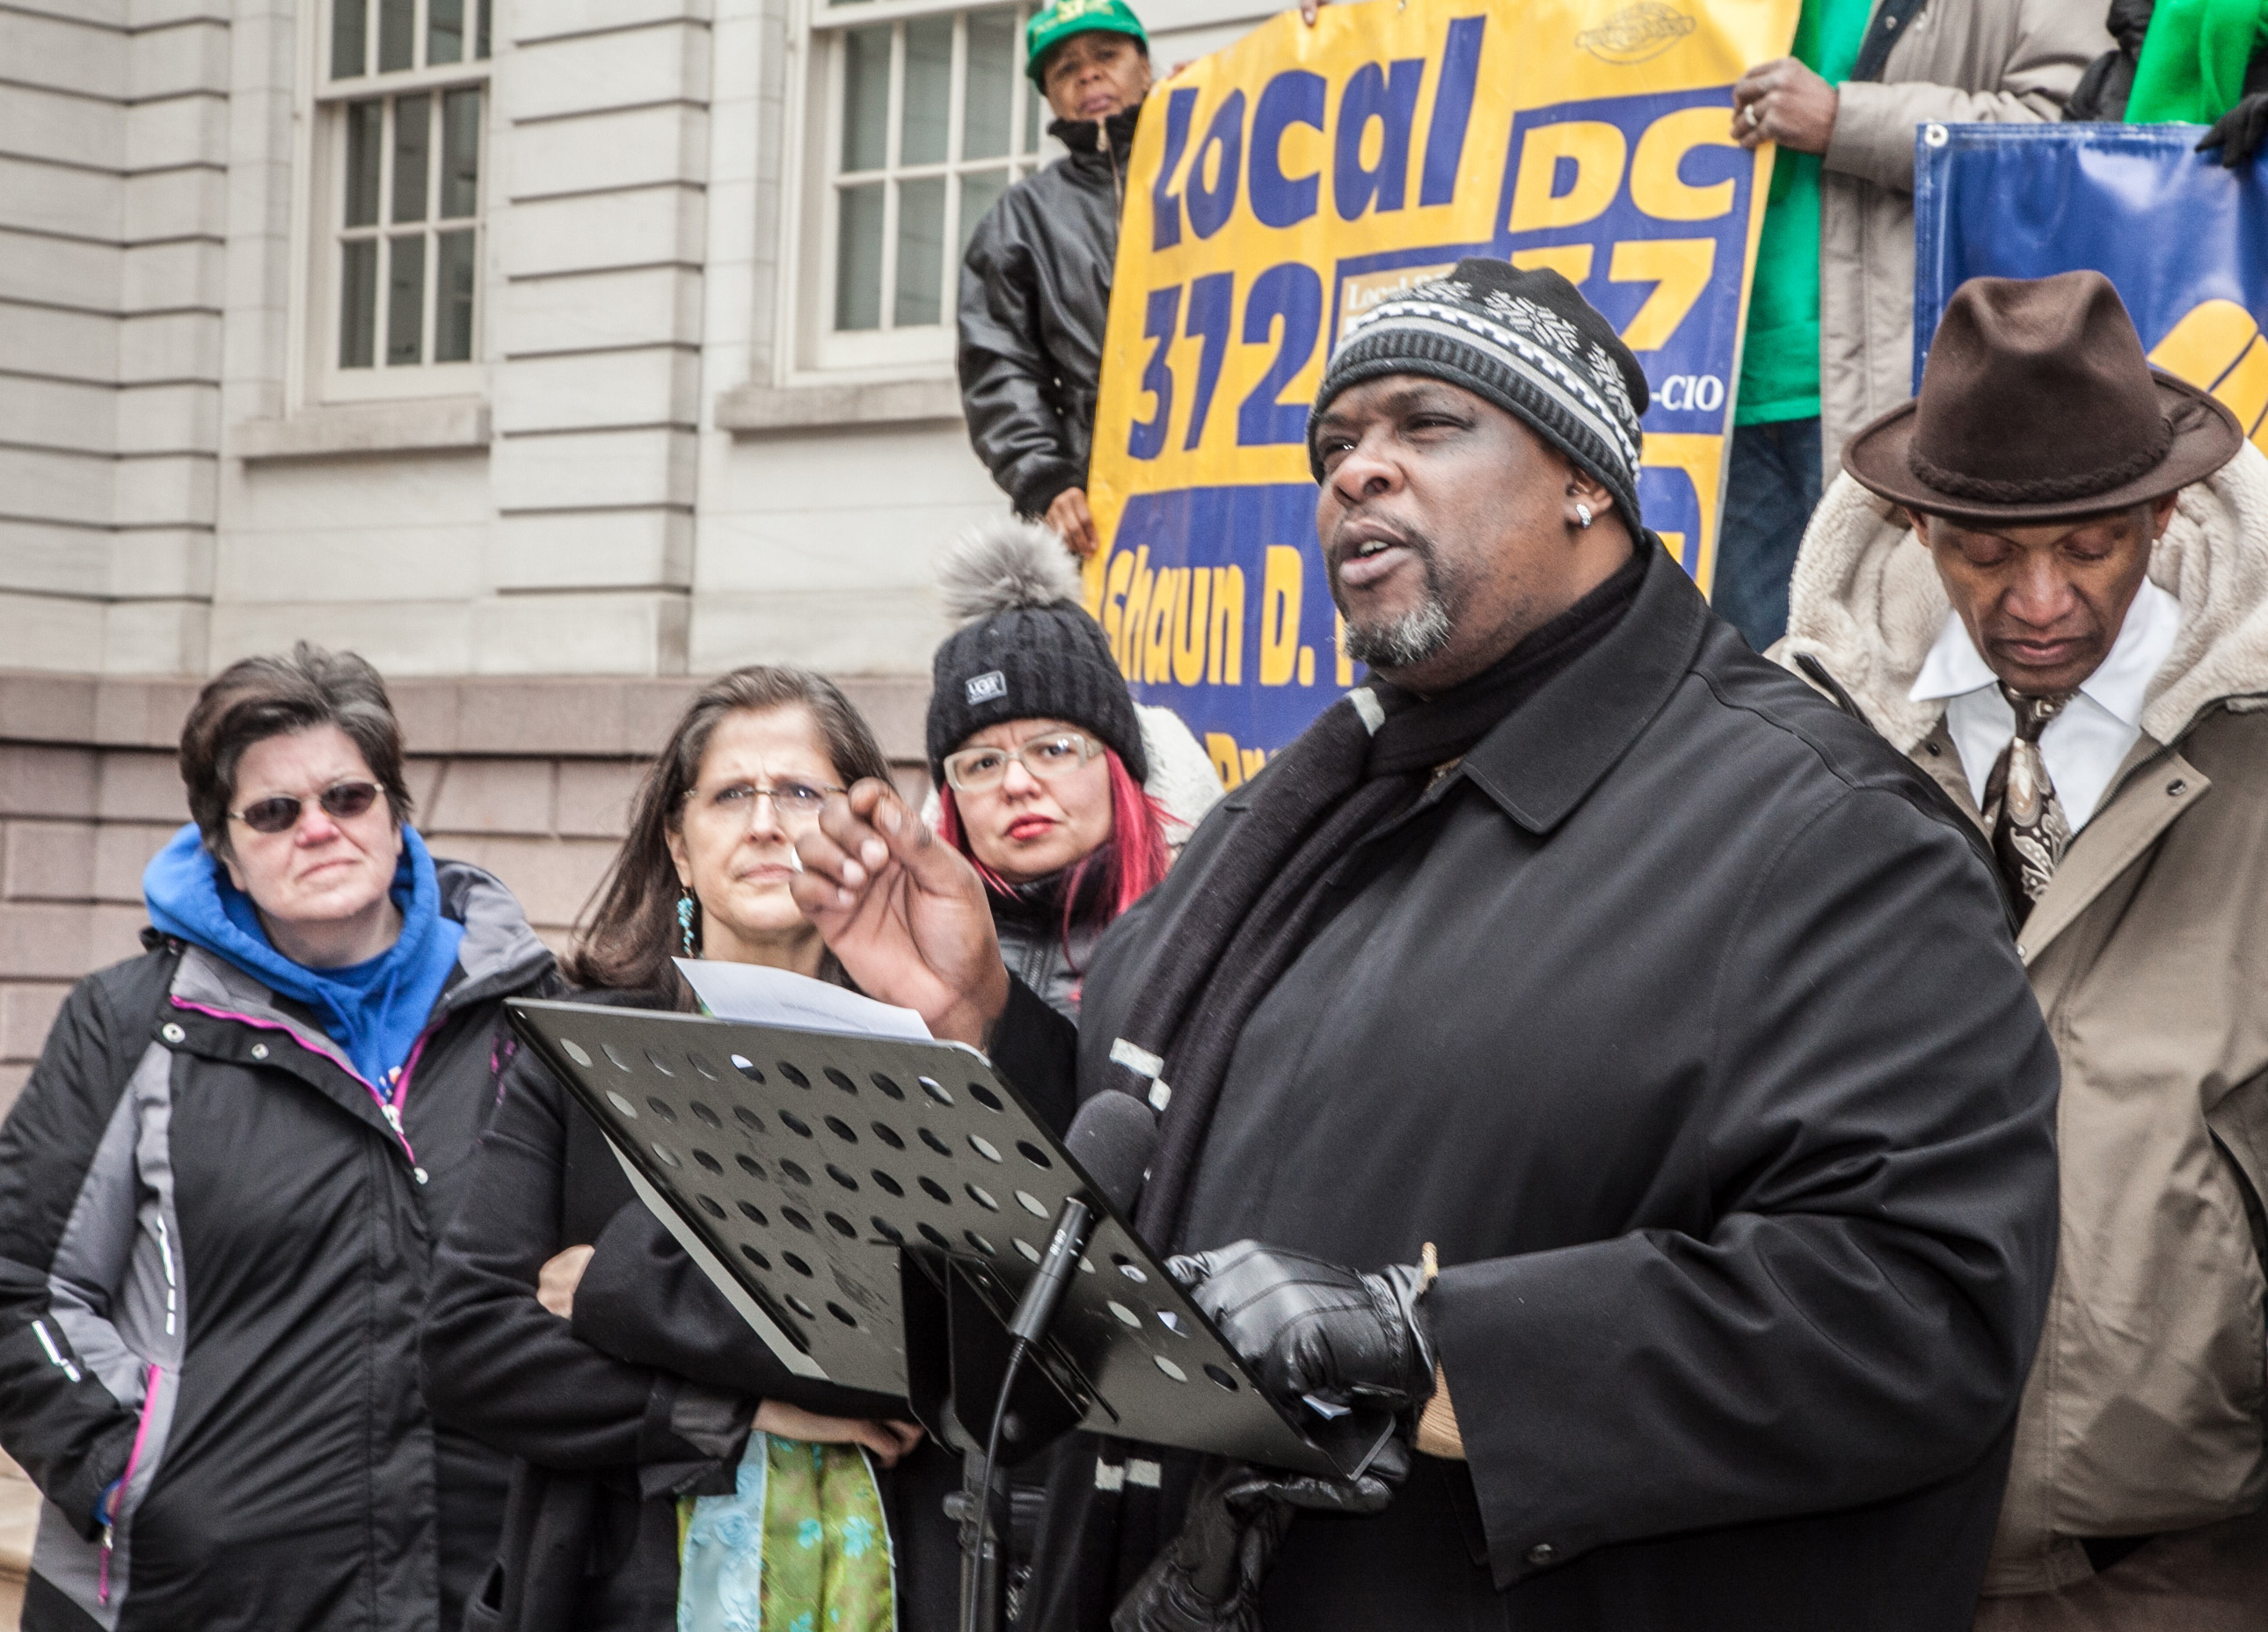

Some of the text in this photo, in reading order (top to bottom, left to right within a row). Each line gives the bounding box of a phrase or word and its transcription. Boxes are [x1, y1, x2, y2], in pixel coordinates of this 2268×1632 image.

[1152, 14, 1487, 253] Local
[1507, 105, 1740, 234] DC
[1102, 543, 1245, 687] Shaun
[1258, 544, 1316, 688] D.
